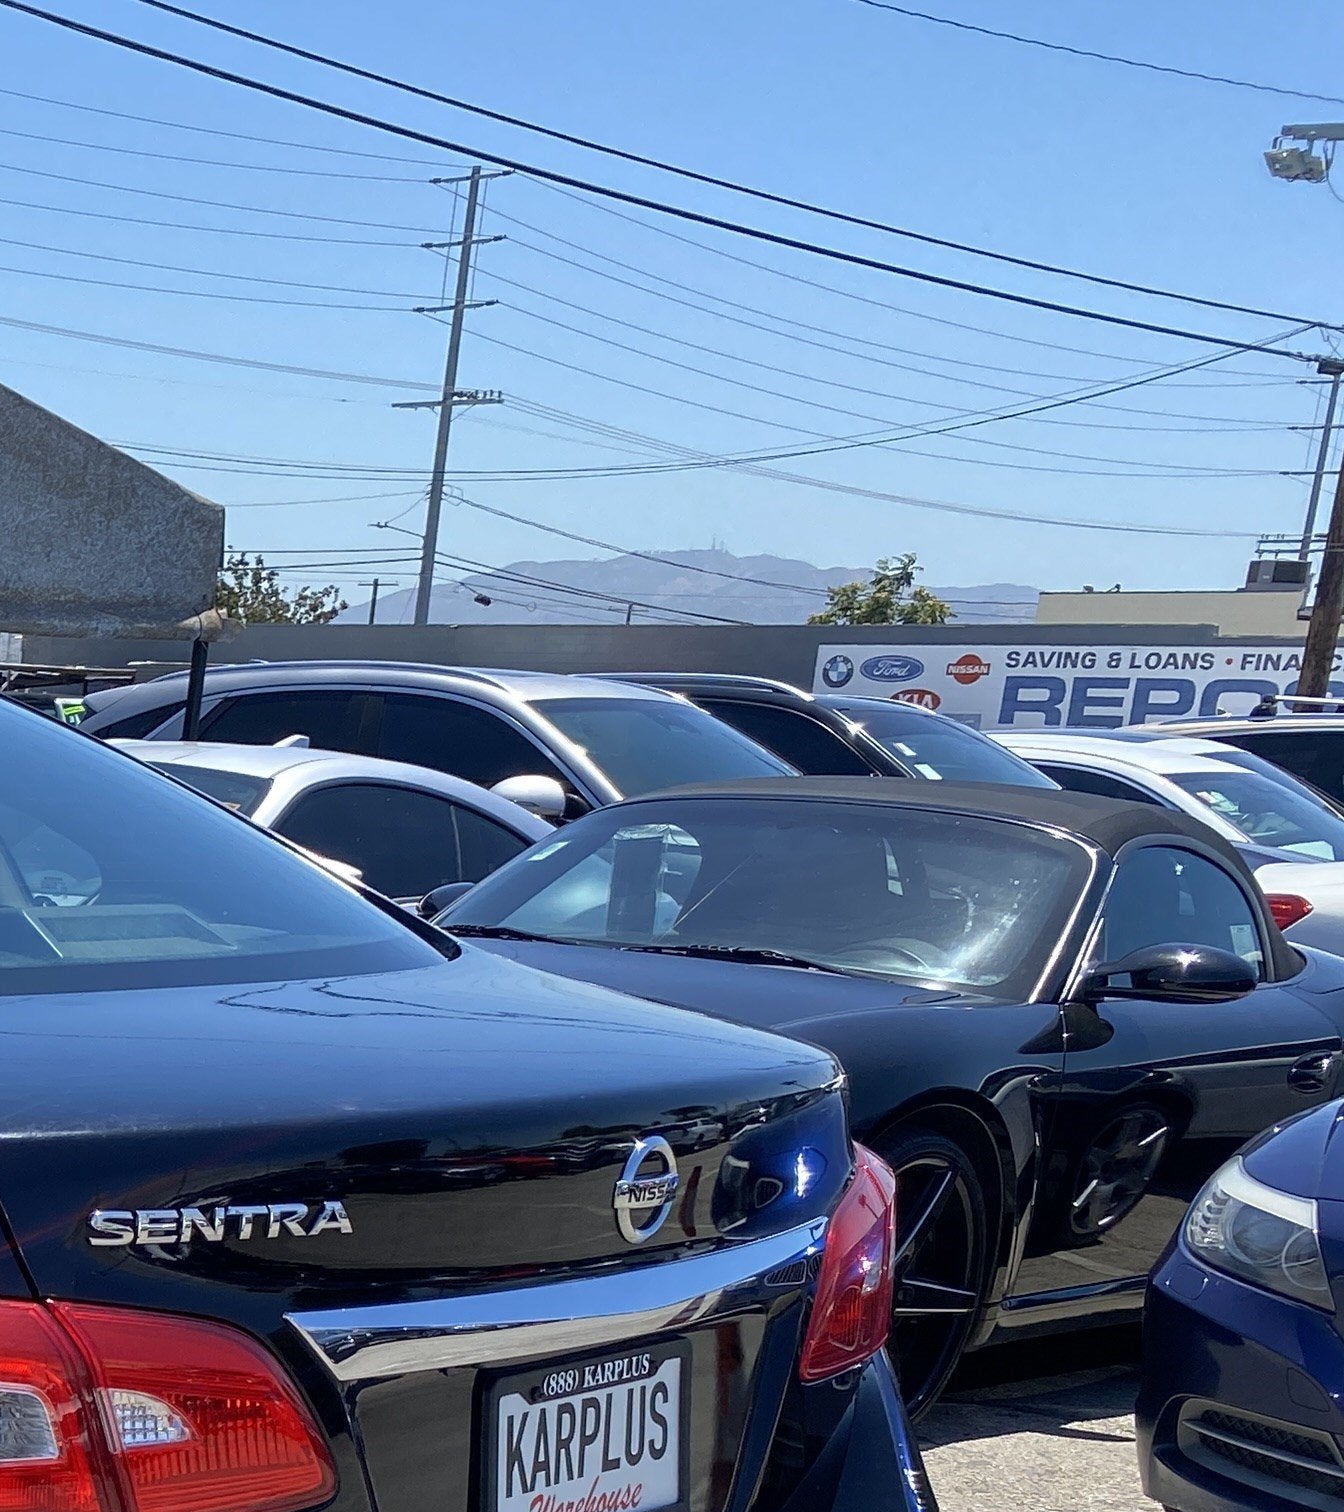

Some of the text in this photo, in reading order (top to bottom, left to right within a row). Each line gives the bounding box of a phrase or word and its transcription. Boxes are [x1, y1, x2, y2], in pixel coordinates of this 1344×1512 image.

[873, 660, 911, 677] Ford
[947, 665, 990, 675] NISSAN
[1005, 651, 1344, 672] SAVING & LOANS FINAC
[89, 1201, 353, 1246] SENTRA
[543, 1354, 651, 1397] (888) KARPLUS
[505, 1381, 669, 1498] KARPLUS
